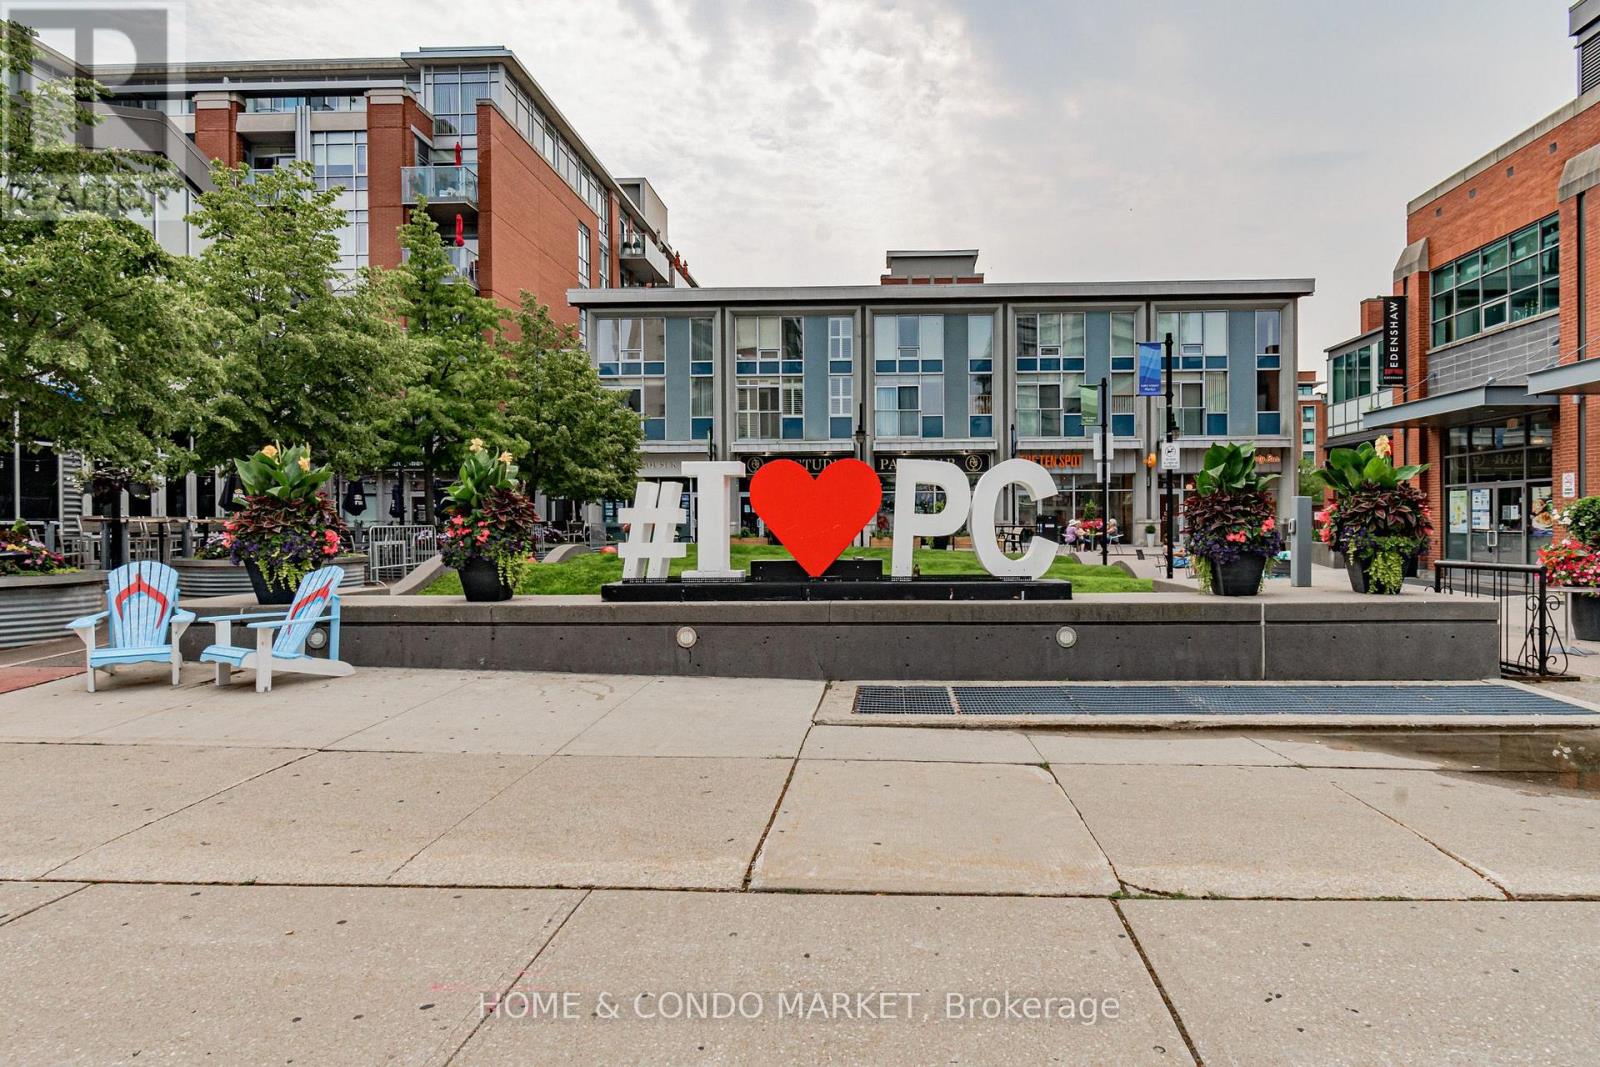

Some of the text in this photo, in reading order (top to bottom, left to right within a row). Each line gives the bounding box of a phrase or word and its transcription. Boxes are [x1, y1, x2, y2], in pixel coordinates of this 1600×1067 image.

[1389, 301, 1399, 368] EDENSHAW
[1040, 454, 1057, 469] TEN
[1059, 453, 1085, 469] SPOT
[891, 458, 1060, 582] PC
